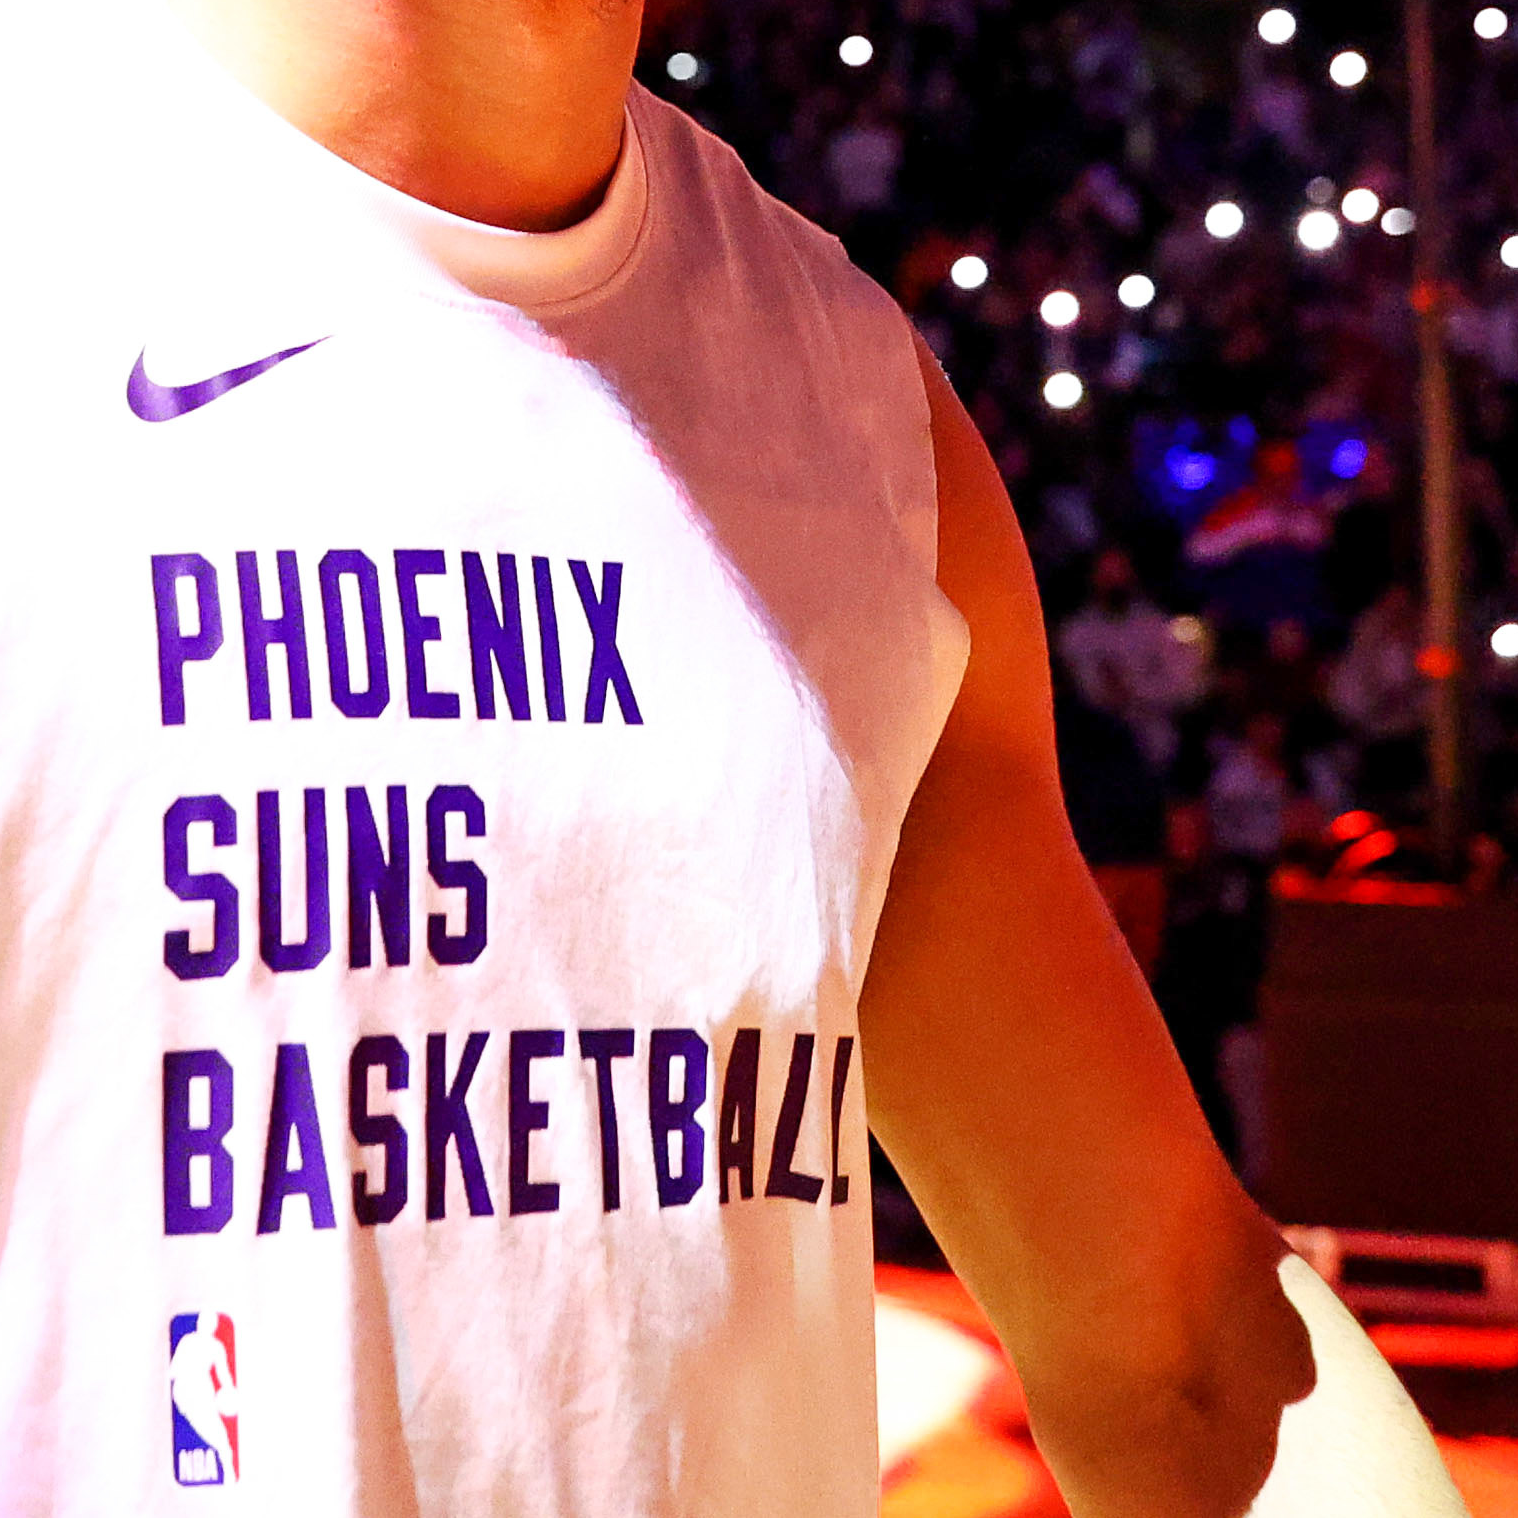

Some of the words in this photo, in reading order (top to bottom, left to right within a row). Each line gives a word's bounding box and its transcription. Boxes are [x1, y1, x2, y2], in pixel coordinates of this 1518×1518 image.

[151, 549, 644, 726] PHOENIX
[163, 784, 488, 981] SUNS
[162, 1027, 856, 1237] BASKETBALL
